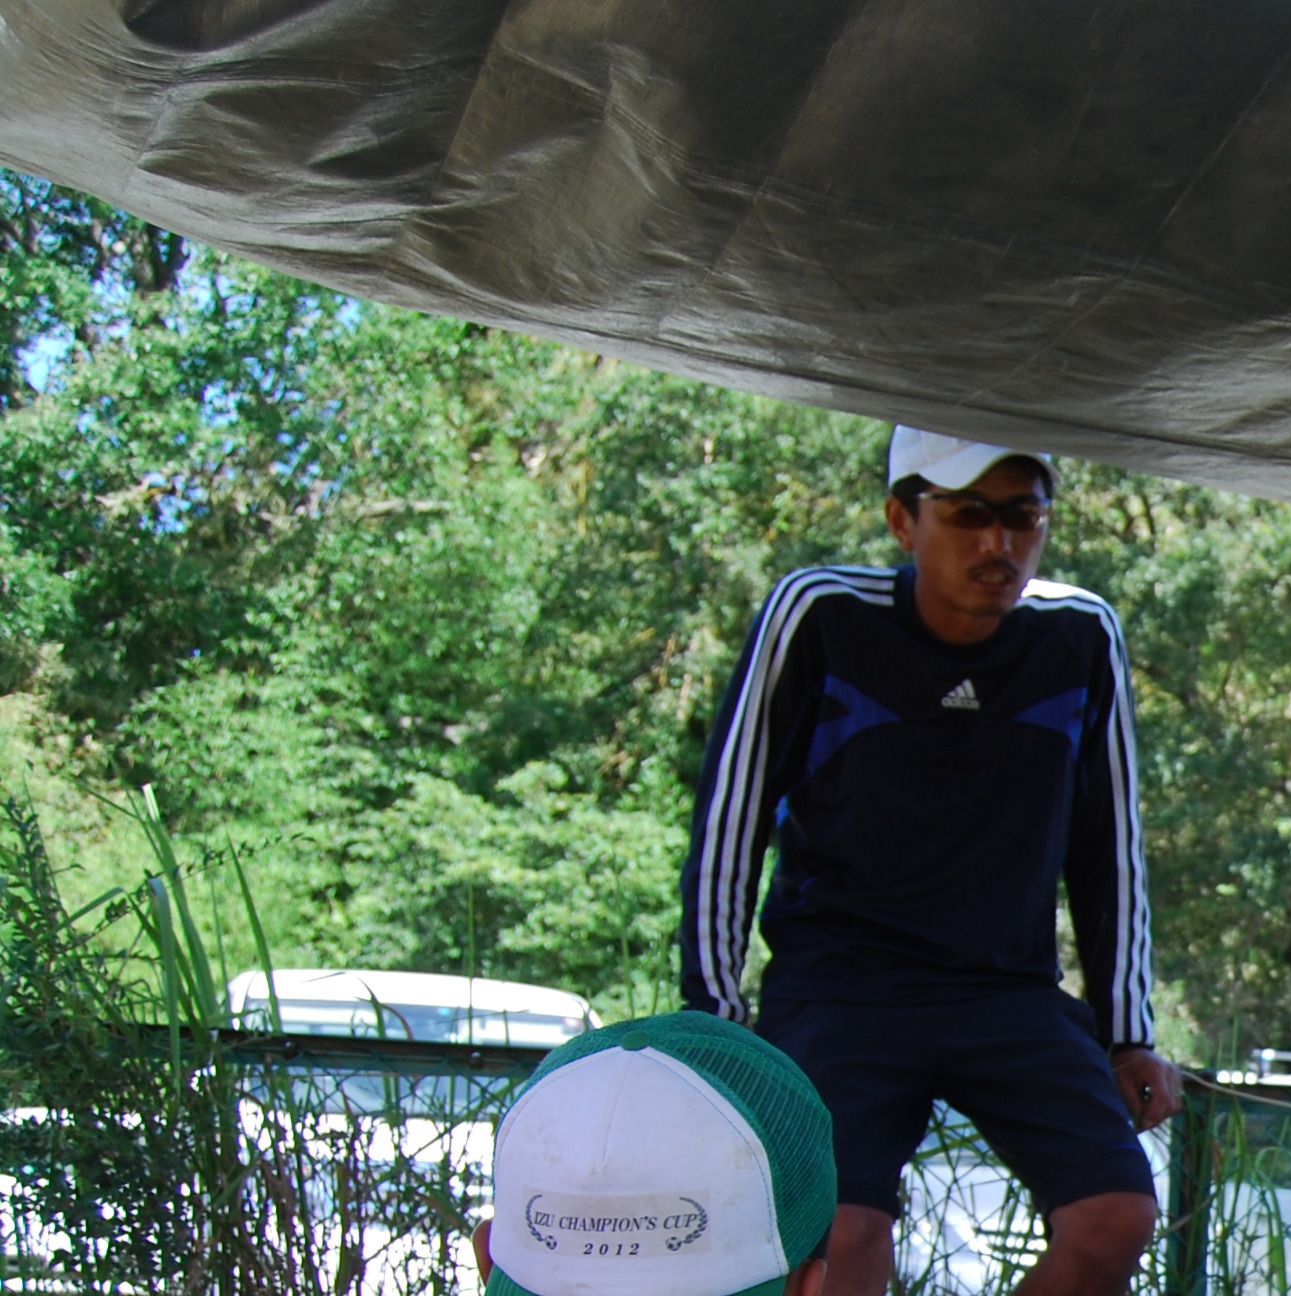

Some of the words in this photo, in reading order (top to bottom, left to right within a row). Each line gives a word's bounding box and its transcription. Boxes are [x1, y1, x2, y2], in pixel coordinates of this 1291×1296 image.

[533, 1210, 555, 1226] IZU
[558, 1214, 657, 1233] CHAMPION'S
[663, 1213, 699, 1230] CUP
[583, 1242, 640, 1257] 2012
